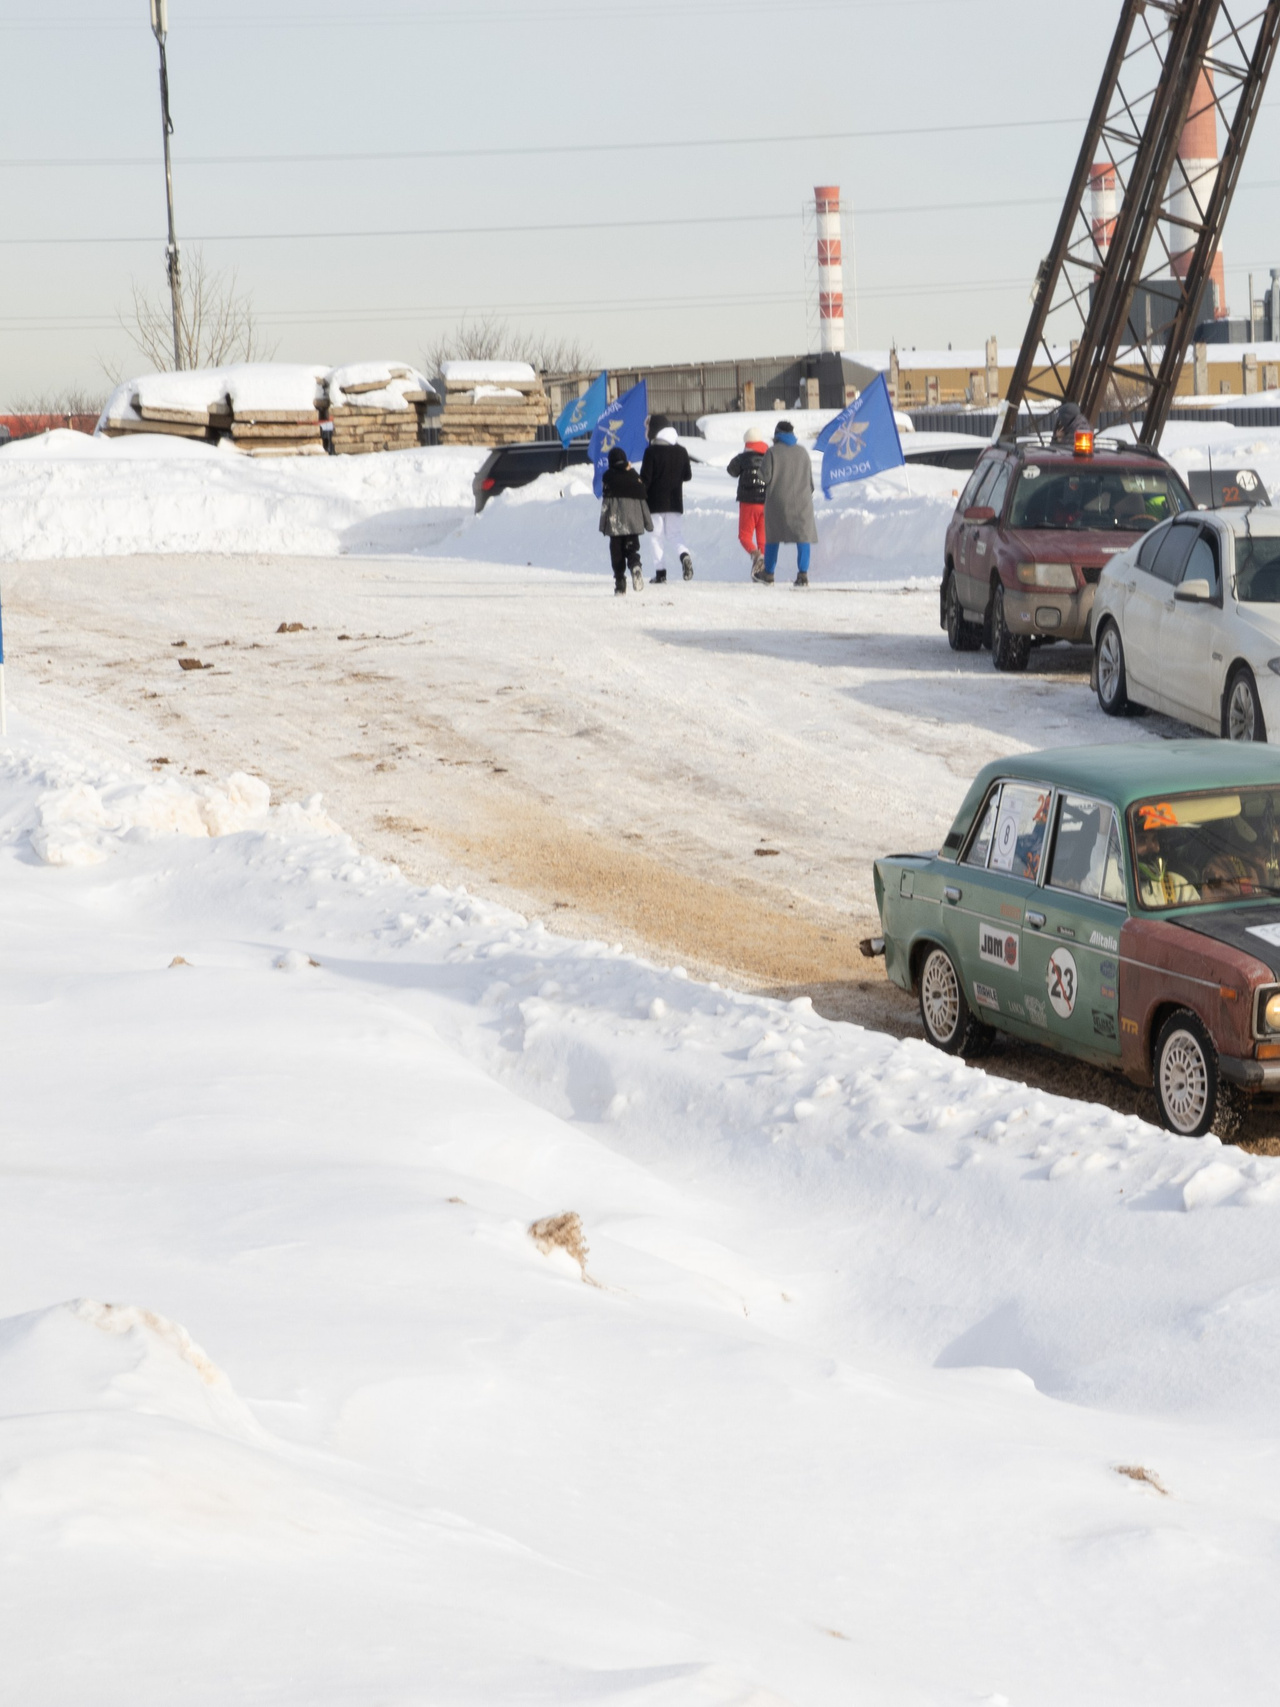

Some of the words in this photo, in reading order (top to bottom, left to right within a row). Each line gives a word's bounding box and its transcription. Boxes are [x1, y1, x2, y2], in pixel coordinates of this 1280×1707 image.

[1004, 825, 1011, 846] 8
[1089, 930, 1118, 951] Alitalia
[1051, 963, 1074, 1002] 23
